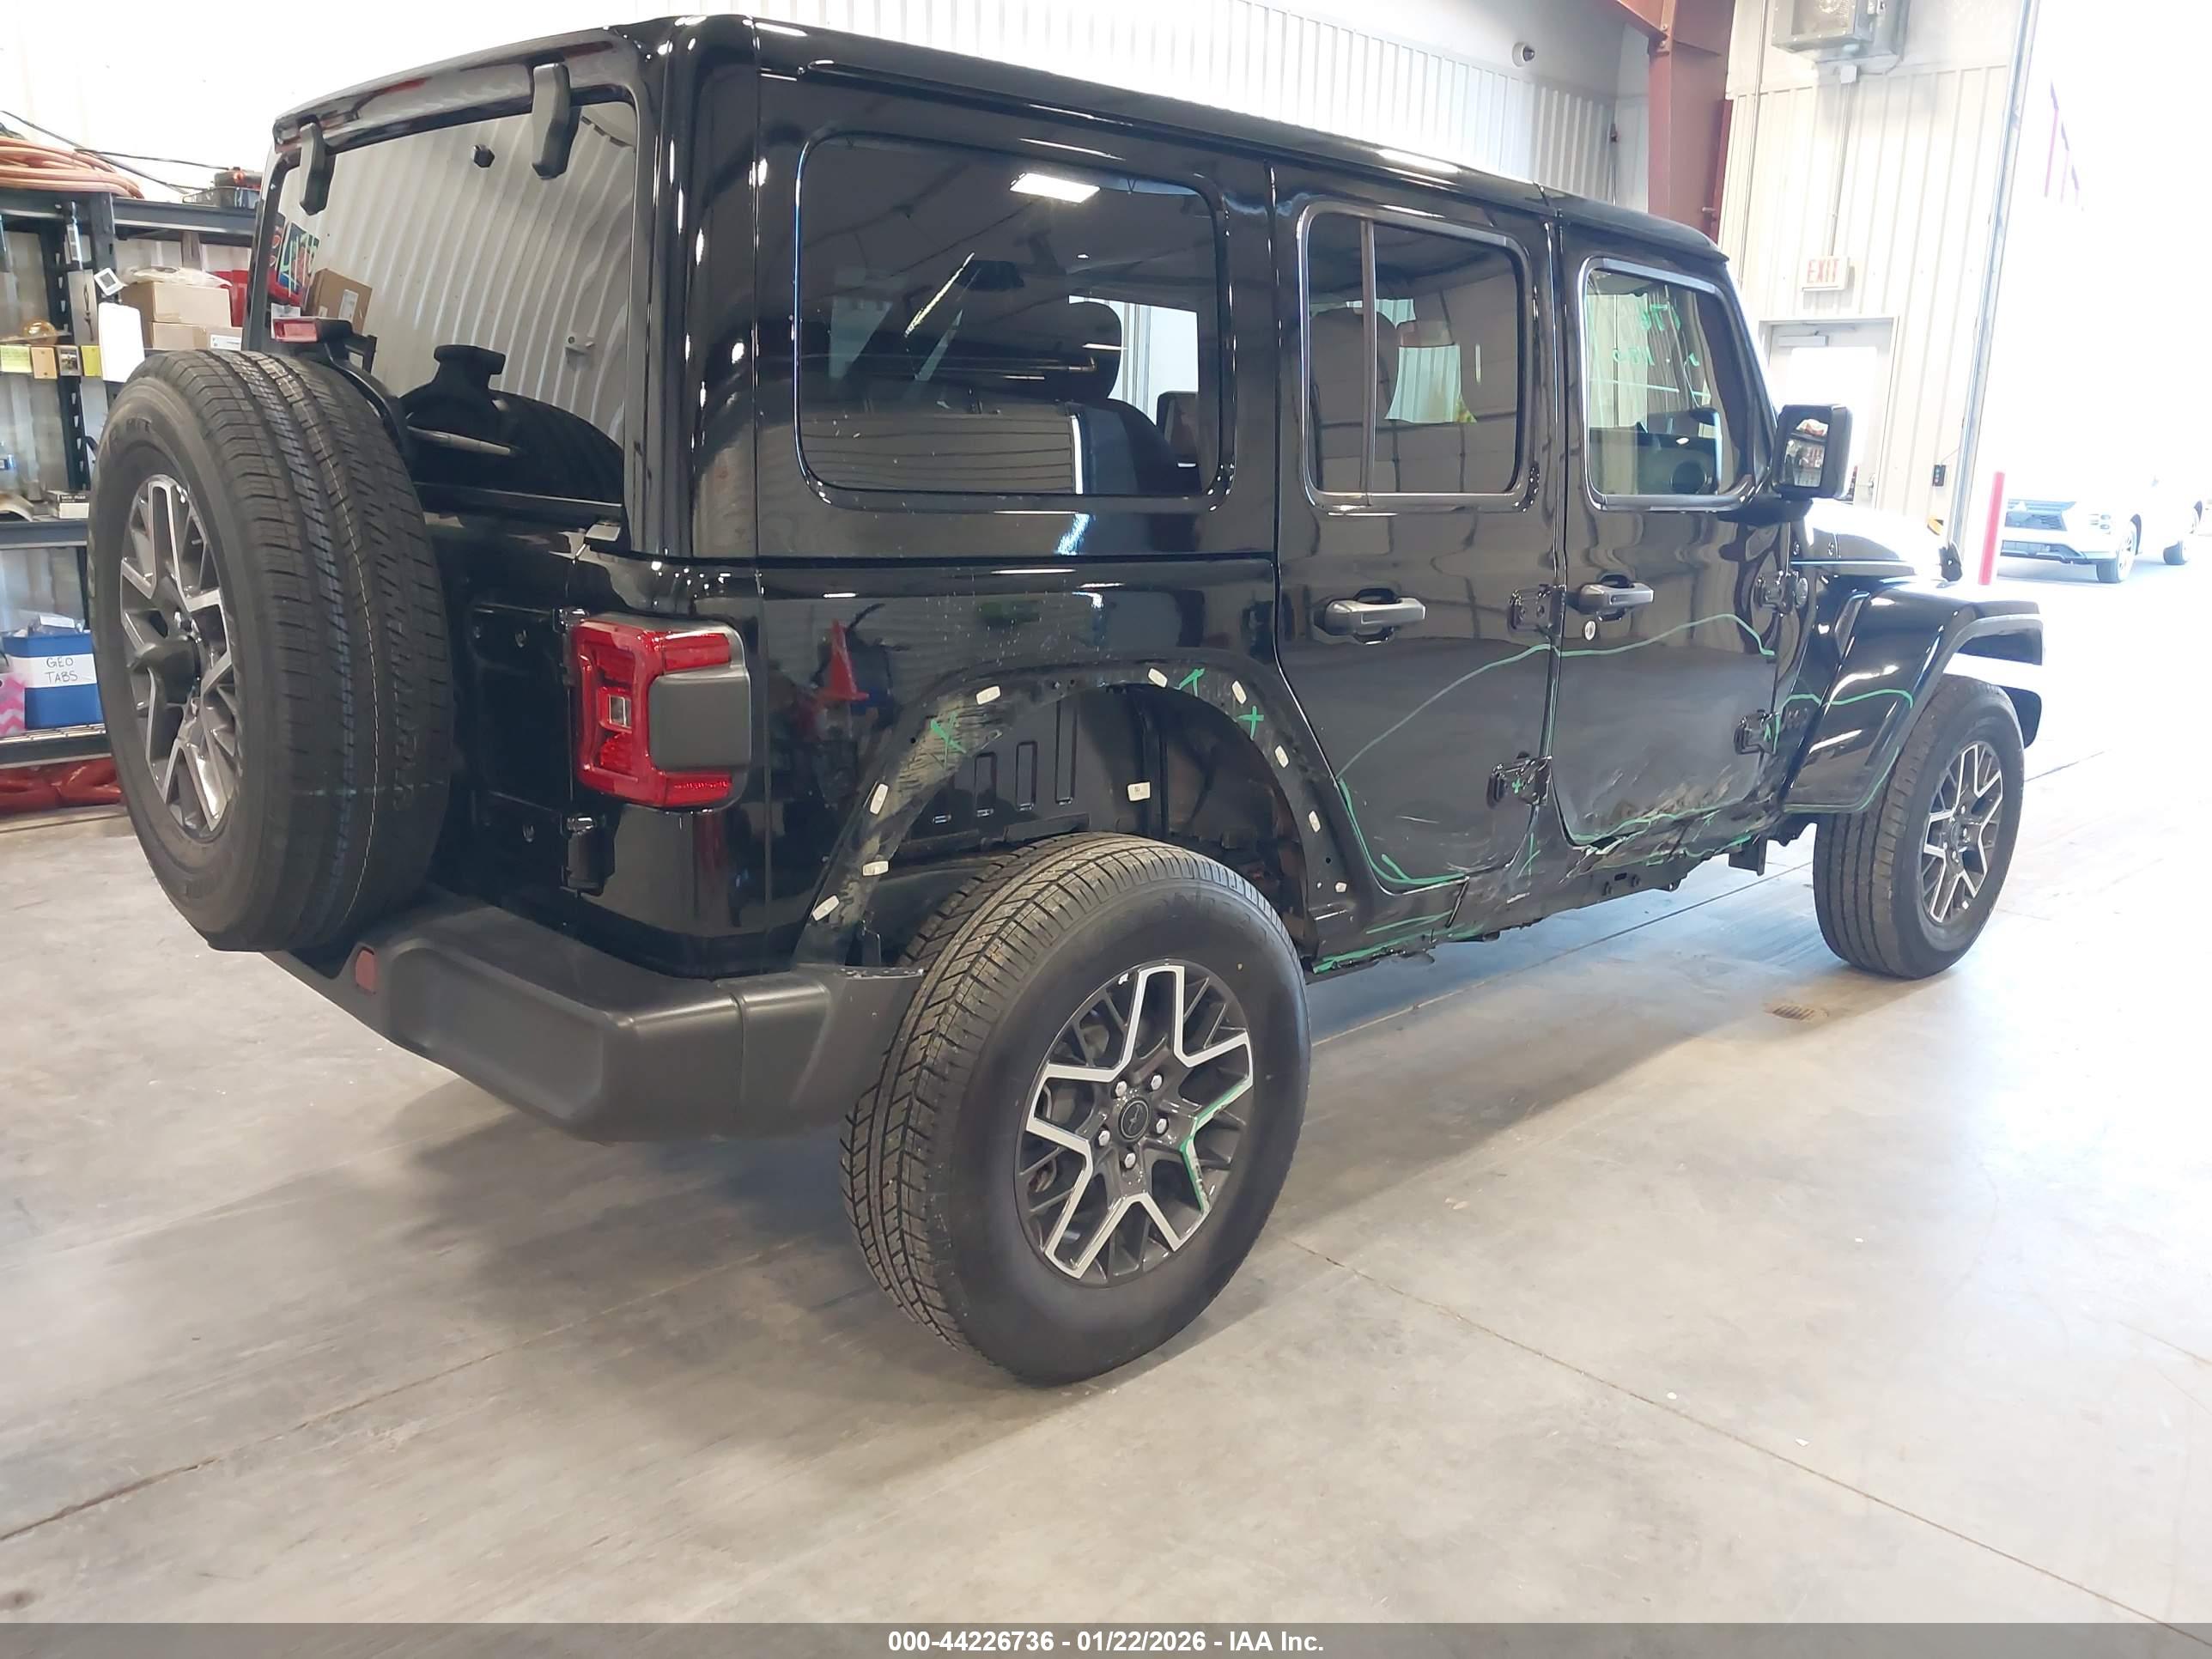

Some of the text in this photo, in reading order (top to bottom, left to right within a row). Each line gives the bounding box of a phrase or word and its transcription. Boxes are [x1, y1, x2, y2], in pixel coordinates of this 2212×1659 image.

[1806, 258, 1839, 283] EXIT
[46, 657, 74, 668] GEO
[44, 670, 78, 684] TABS
